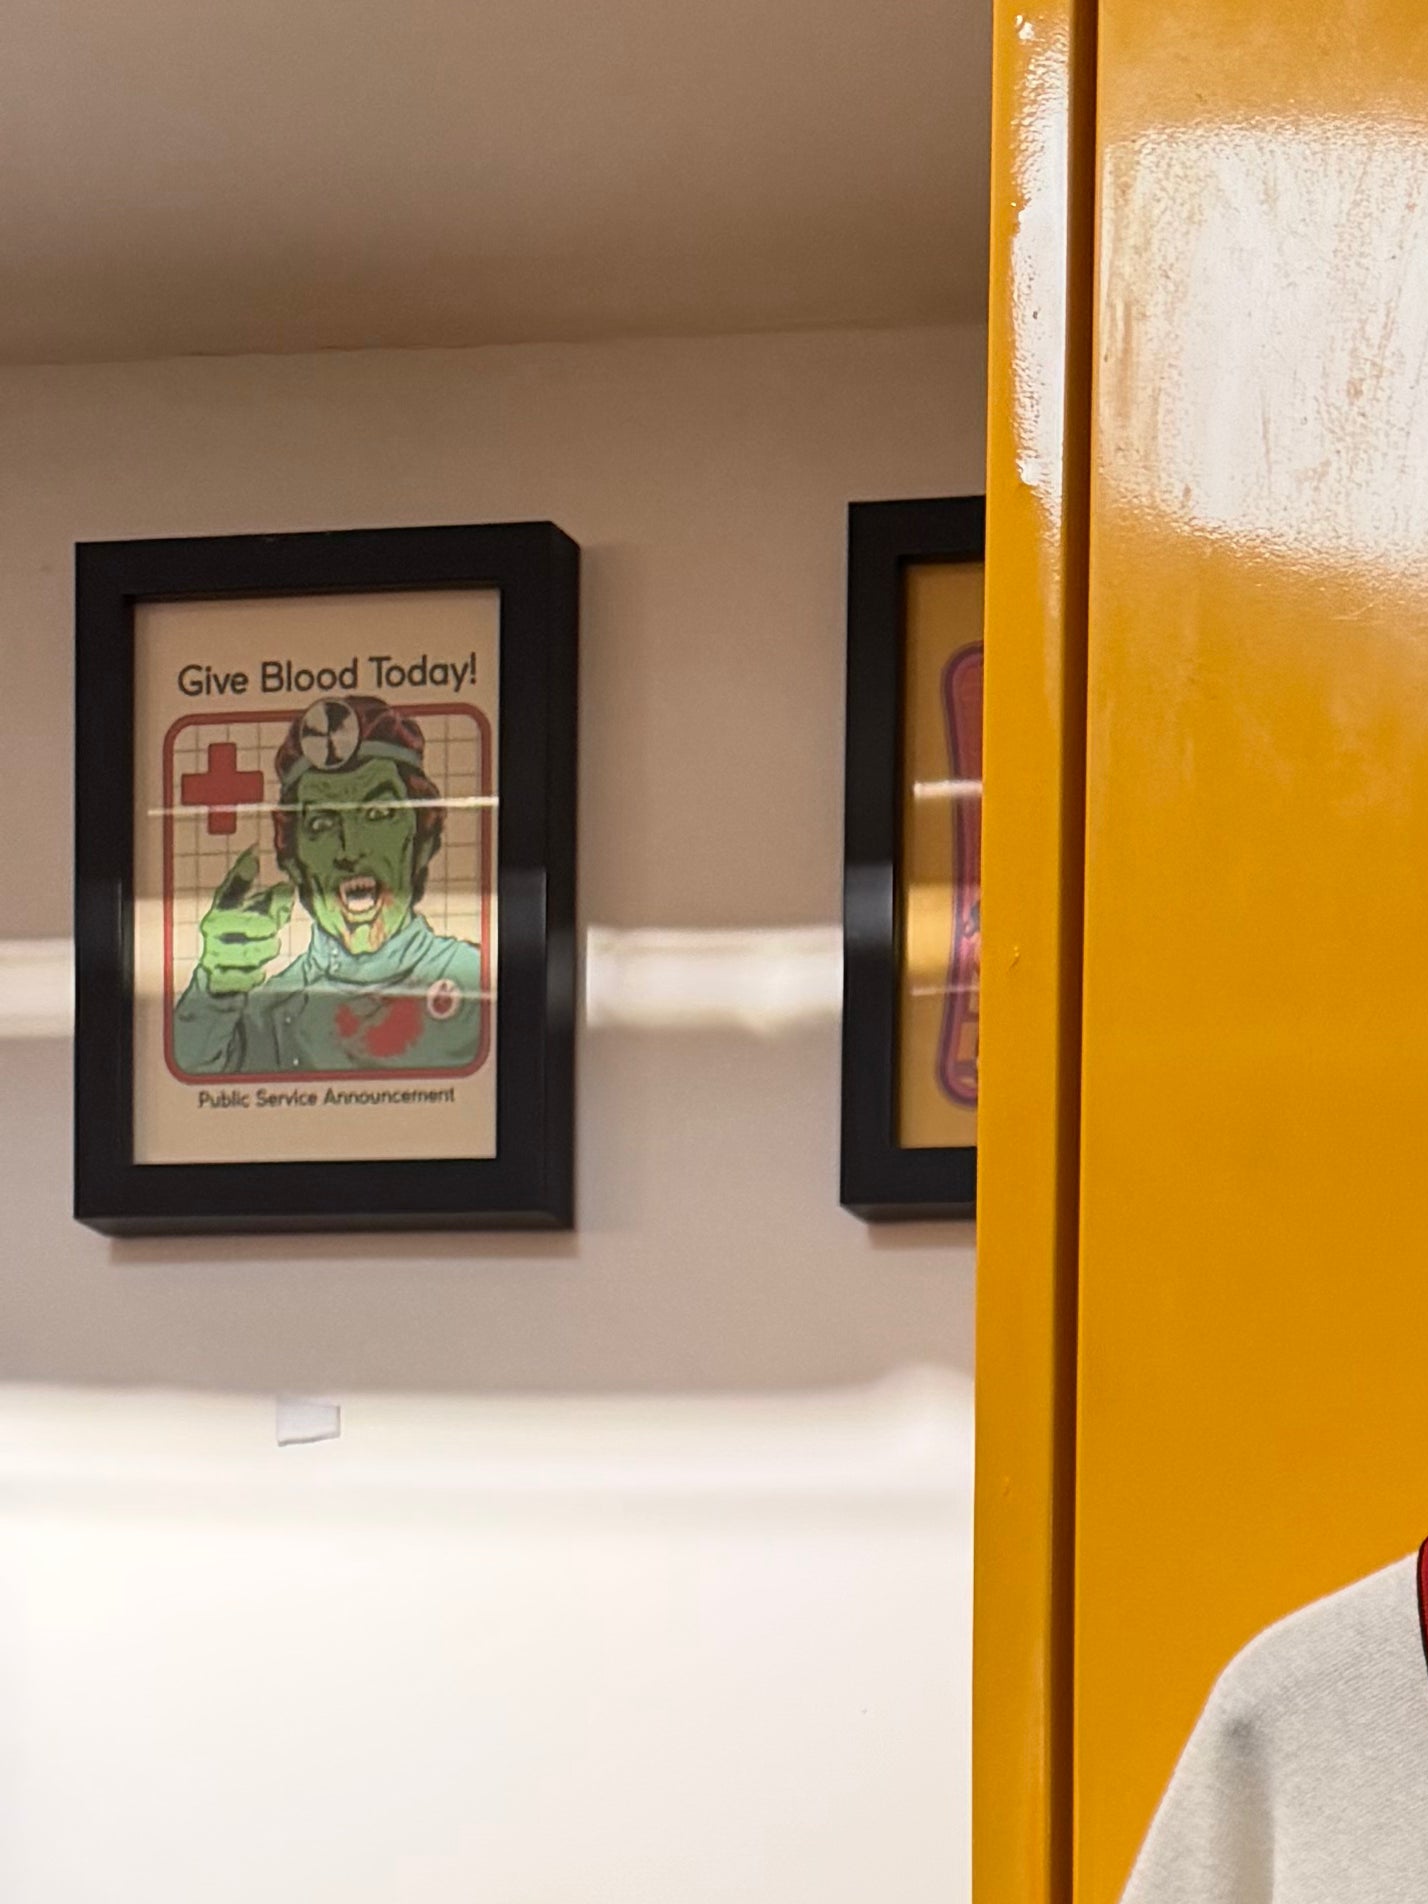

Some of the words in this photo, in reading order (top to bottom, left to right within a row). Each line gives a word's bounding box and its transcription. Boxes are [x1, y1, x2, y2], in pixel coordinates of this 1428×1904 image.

[177, 664, 249, 697] Give
[260, 656, 359, 693] Blood
[367, 651, 477, 692] Today!
[197, 1089, 251, 1109] Public
[255, 1088, 318, 1108] Service
[322, 1086, 456, 1106] Announcement
